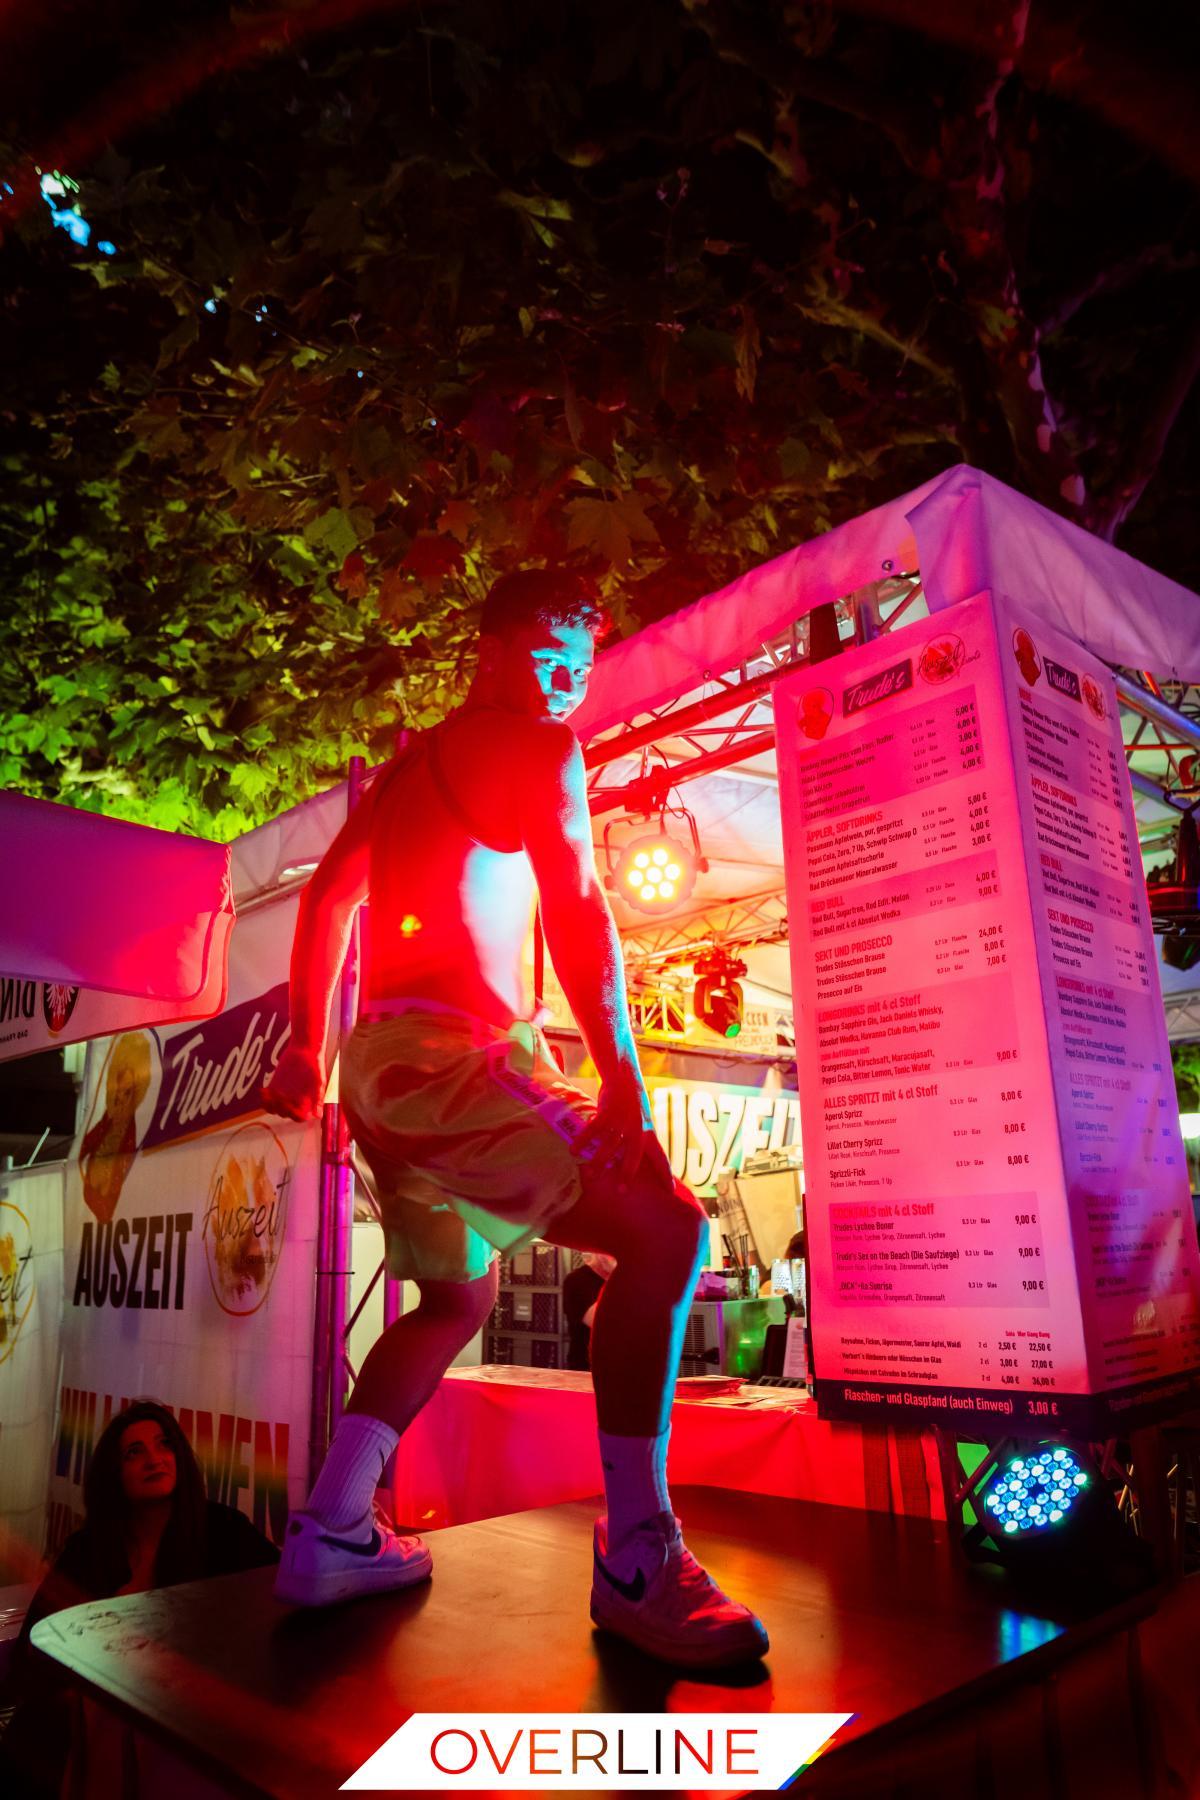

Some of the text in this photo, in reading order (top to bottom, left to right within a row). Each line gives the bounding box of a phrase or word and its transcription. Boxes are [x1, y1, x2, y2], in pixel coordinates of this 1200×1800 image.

[848, 670, 905, 711] Trude's
[967, 793, 981, 805] 5,00
[968, 807, 982, 819] 4,00
[835, 809, 883, 834] SOFTDRINKS
[863, 828, 875, 838] pur,
[875, 818, 903, 834] gespritzt
[969, 820, 984, 833] 4,00
[971, 834, 985, 846] 3,00
[822, 851, 836, 863] Cola,
[836, 846, 851, 858] Zero,
[851, 845, 855, 853] 7
[855, 842, 865, 853] Up,
[855, 860, 897, 879] Mineralwasser
[975, 870, 990, 883] 4,00
[978, 885, 992, 897] 9,00
[812, 927, 823, 937] Red
[823, 925, 835, 934] Bull
[835, 922, 845, 931] mit
[845, 921, 850, 929] 4
[880, 908, 900, 920] Wodka
[822, 911, 835, 922] Bull,
[978, 925, 997, 938] 24,00
[814, 934, 892, 962] SEKT UND PROSECCO
[984, 940, 998, 952] 8,00
[863, 950, 885, 963] Brause
[986, 954, 1000, 966] 7,00
[817, 983, 862, 1000] Prosecco auf Eis
[866, 1000, 881, 1013] mit
[881, 999, 888, 1011] 4
[888, 997, 898, 1009] cl
[898, 993, 921, 1007] Stoff
[840, 1018, 866, 1032] Sapphire
[878, 1013, 893, 1023] Jack
[893, 1009, 917, 1021] Daniels
[917, 1004, 943, 1018] Whisky,
[886, 1026, 901, 1036] Club
[901, 1023, 918, 1035] Rum,
[821, 1048, 934, 1074] Orangensaft, Kirschsaft, Maracujasaft,
[996, 1050, 1011, 1062] 9,00
[821, 1062, 931, 1087] Pepsi Cola, Bitter Lemon, Tonic Water
[823, 1083, 938, 1109] ALLES SPRITZT mit 4 cl Stoff
[1000, 1090, 1016, 1101] 8,00
[824, 1109, 862, 1123] Aperol Sprizz
[1003, 1122, 1019, 1134] 8,00
[842, 1139, 863, 1150] Cherry
[863, 1137, 883, 1148] Sprizz
[1007, 1154, 1023, 1165] 8,00
[202, 1168, 291, 1241] Auszeit
[877, 1205, 893, 1217] mit
[893, 1204, 900, 1216] 4
[900, 1204, 910, 1216] cl
[910, 1202, 935, 1216] Stoff
[1014, 1214, 1029, 1226] 9,00
[857, 1252, 869, 1261] Sex
[878, 1251, 889, 1260] the
[889, 1251, 910, 1260] Beach
[910, 1250, 924, 1261] (Die
[924, 1249, 960, 1261] Saufziege)
[1018, 1247, 1033, 1258] 9,00
[73, 1212, 193, 1310] AUSZEIT
[1021, 1280, 1037, 1291] 9,00
[998, 1342, 1011, 1350] 2,50
[1028, 1342, 1045, 1352] 22,50
[999, 1358, 1012, 1368] 3,00
[1030, 1359, 1047, 1369] 27,00
[844, 1388, 1013, 1414] Flaschen- und Glaspfand (auch Einweg)
[1027, 1400, 1049, 1415] 3,00
